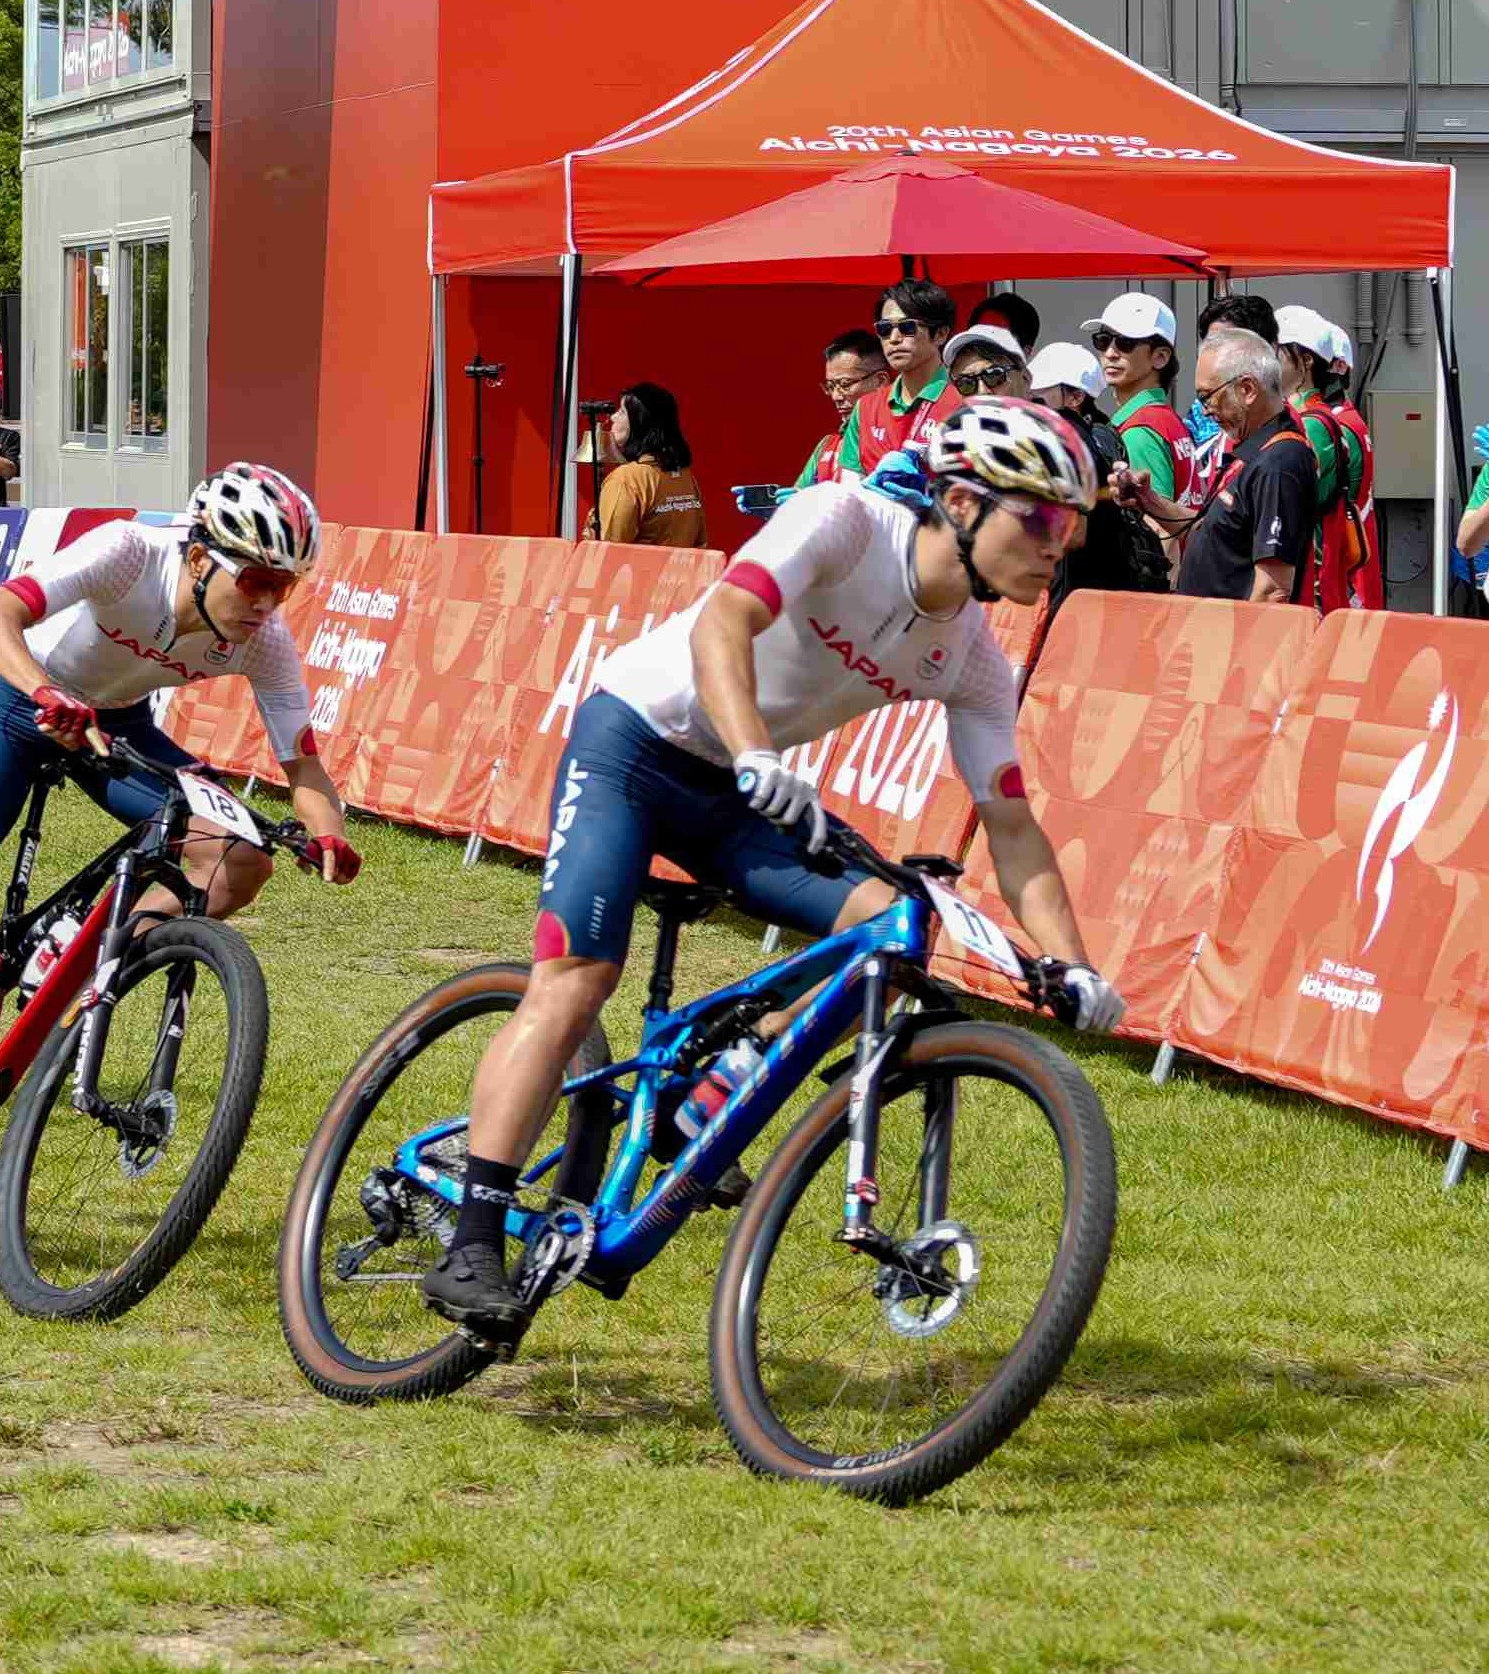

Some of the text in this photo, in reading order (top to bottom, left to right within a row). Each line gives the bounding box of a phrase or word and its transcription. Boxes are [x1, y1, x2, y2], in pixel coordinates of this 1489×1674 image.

[759, 136, 1238, 162] Aichi-Nagoya 2026
[827, 125, 1149, 146] 20th Asian Games
[832, 699, 950, 821] 2026
[199, 787, 238, 823] 18
[953, 902, 993, 946] 11
